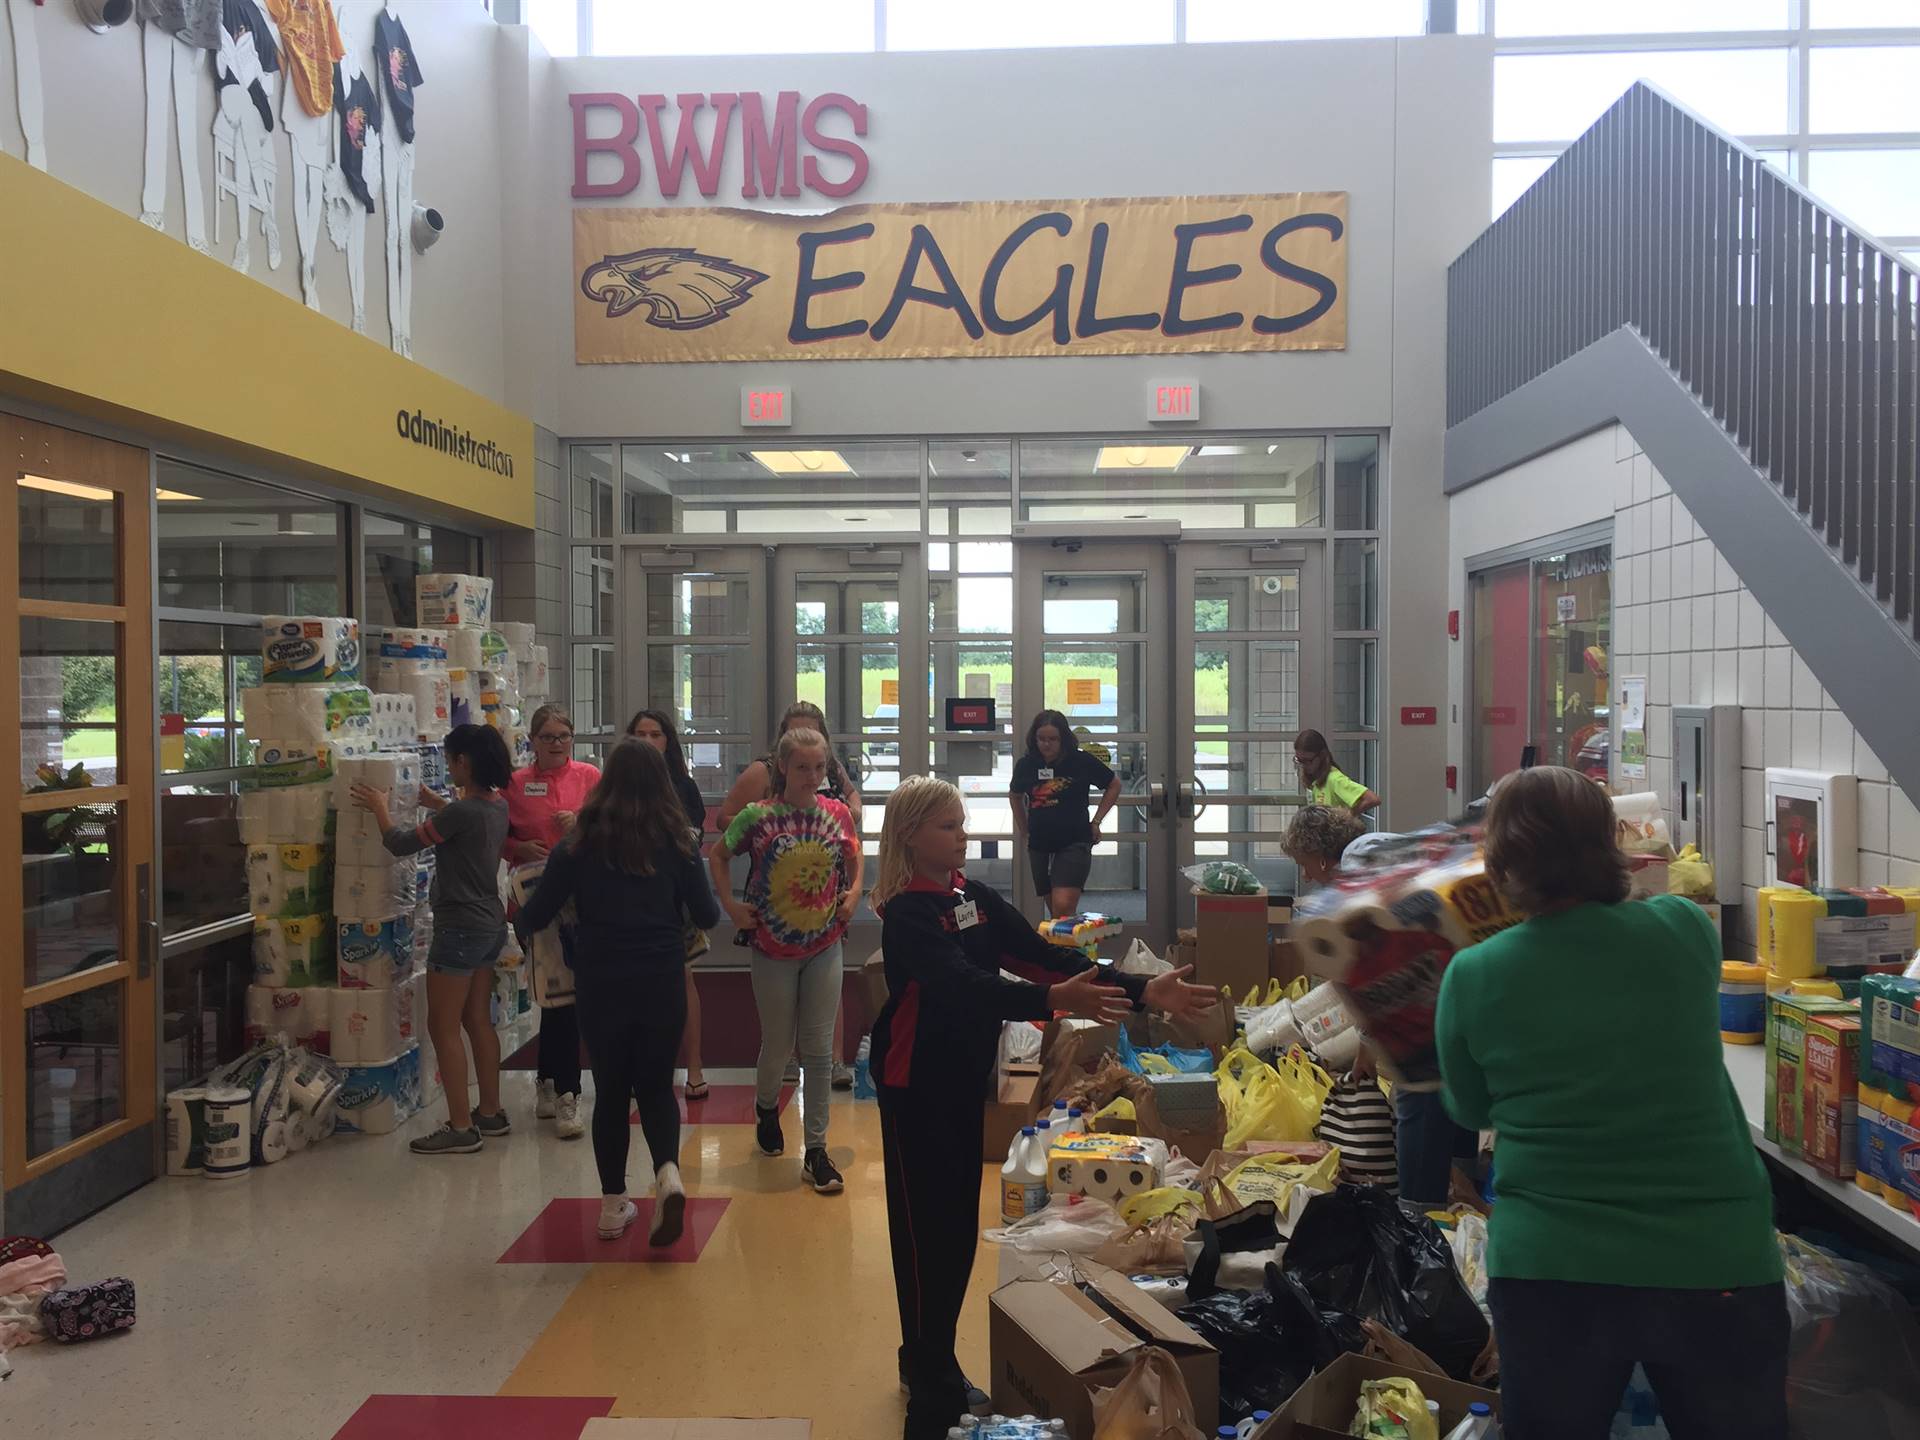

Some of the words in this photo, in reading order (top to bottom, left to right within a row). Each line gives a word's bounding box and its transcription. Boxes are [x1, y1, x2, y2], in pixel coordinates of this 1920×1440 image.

[569, 91, 869, 198] BWMS
[787, 211, 1345, 346] EAGLES
[748, 392, 784, 421] EXIT
[1157, 386, 1192, 417] EXIT
[396, 409, 514, 479] administration
[963, 711, 978, 719] EXIT
[1411, 711, 1427, 720] EXIT
[343, 940, 380, 963] Sparkle
[337, 1085, 380, 1110] Sparkle
